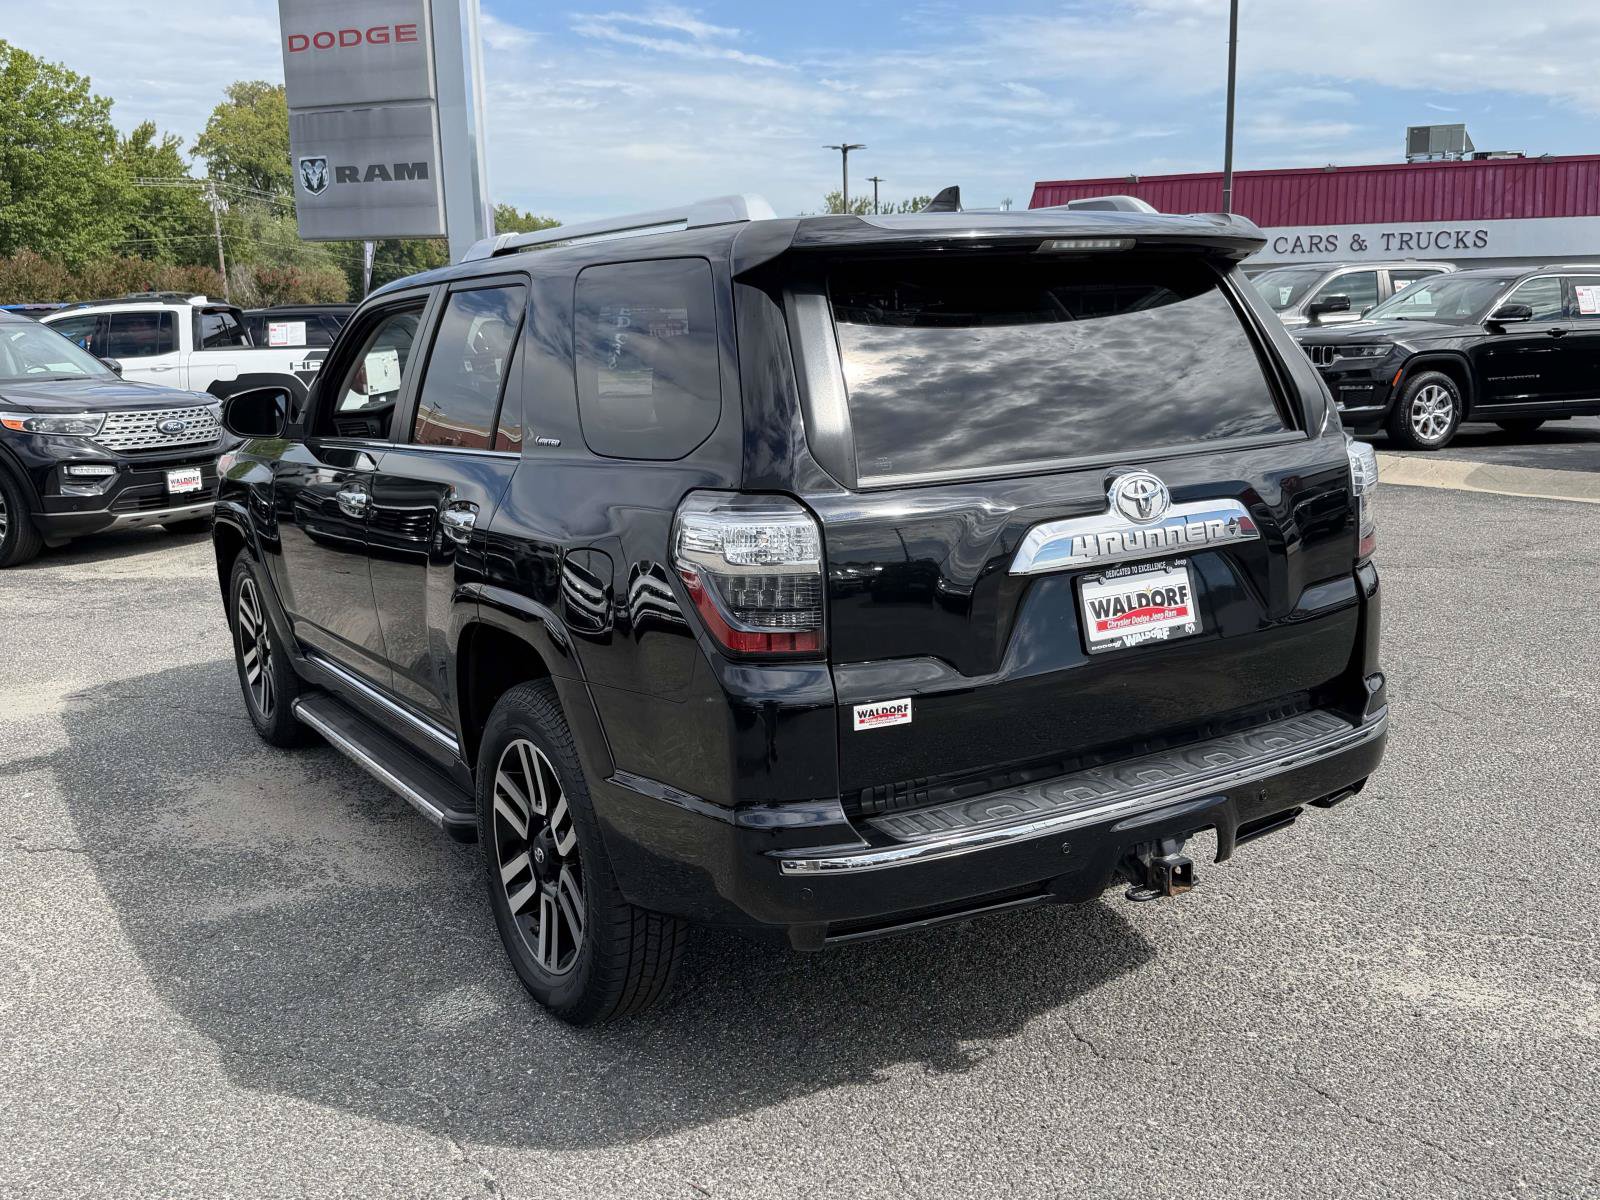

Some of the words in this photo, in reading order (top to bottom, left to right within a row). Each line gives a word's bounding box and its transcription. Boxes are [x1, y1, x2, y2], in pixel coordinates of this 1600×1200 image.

[288, 24, 418, 53] DODGE
[335, 162, 429, 184] RAM
[1273, 235, 1338, 254] CARS
[1350, 233, 1367, 251] &
[1381, 230, 1488, 251] TRUCKS
[170, 476, 200, 485] WALDORF
[1105, 566, 1131, 578] DEDICATED
[1132, 565, 1138, 574] TO
[1138, 561, 1167, 573] EXCELLENCE
[1089, 585, 1188, 620] WALDORF
[1107, 617, 1132, 631] Chrysler
[1132, 614, 1150, 625] Dodge
[1150, 611, 1164, 621] Jeep
[1164, 610, 1177, 619] Ram
[857, 704, 909, 719] WALDORF
